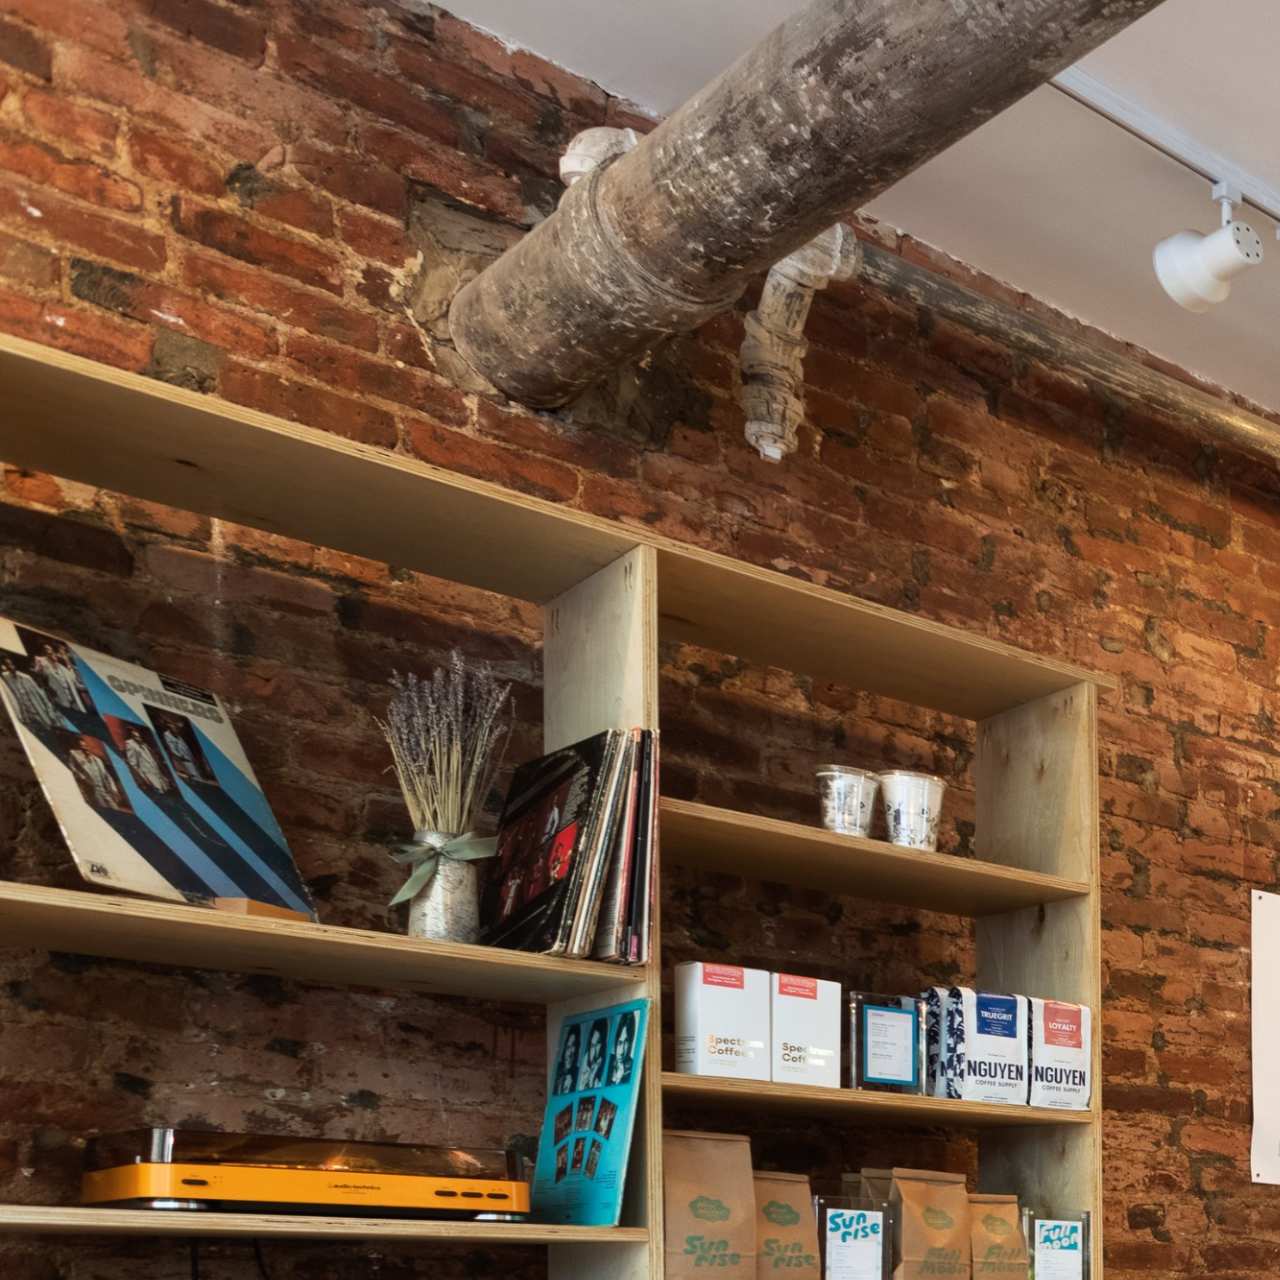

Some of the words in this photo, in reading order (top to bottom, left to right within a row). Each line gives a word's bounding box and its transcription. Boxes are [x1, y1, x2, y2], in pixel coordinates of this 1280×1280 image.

[1048, 1022, 1077, 1032] LOYALTY
[967, 1059, 1024, 1082] NGUYEN
[1034, 1065, 1086, 1087] NGUYEN
[828, 1211, 867, 1233] Sun
[841, 1221, 881, 1243] rise
[684, 1235, 729, 1255] Sun
[763, 1238, 803, 1256] Sun
[694, 1251, 741, 1267] rise
[772, 1253, 816, 1269] rise
